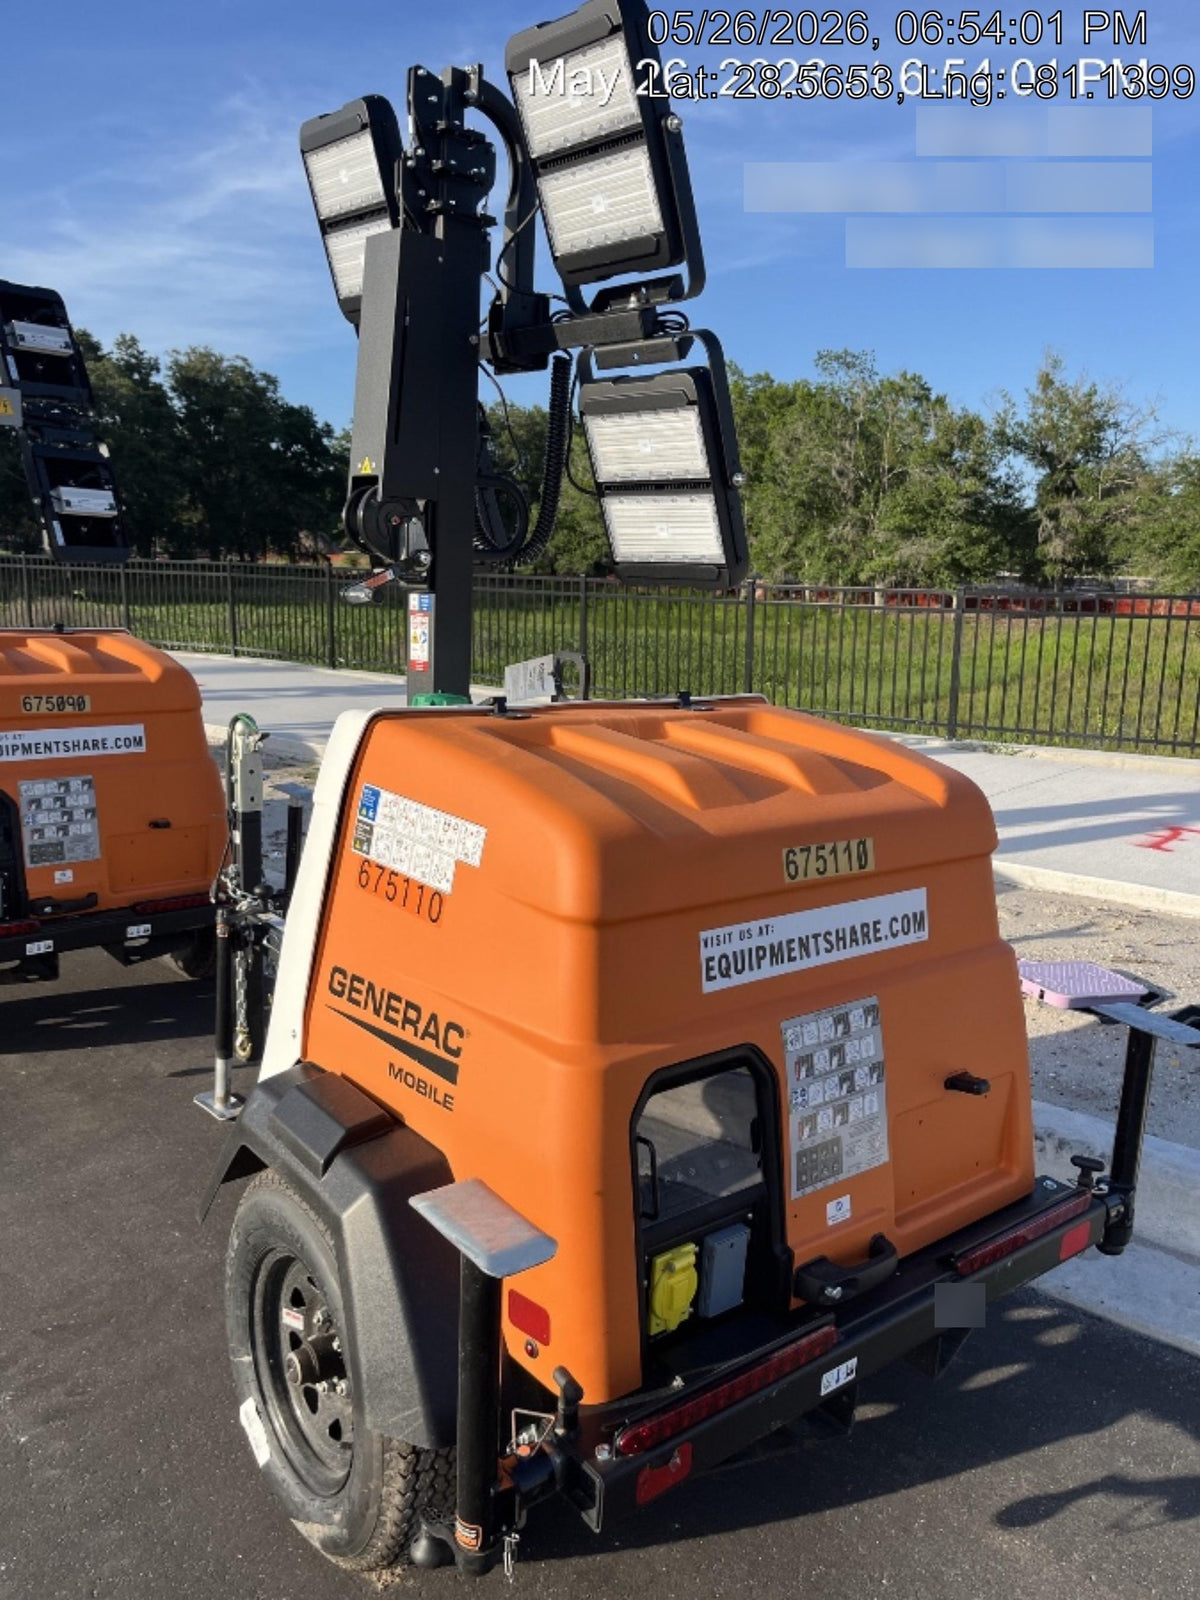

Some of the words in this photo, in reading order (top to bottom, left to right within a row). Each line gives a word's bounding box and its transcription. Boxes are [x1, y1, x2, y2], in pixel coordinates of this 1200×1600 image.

[22, 695, 86, 712] 675090
[785, 838, 868, 881] 675110
[358, 859, 444, 924] 675110
[702, 932, 733, 949] VISIT
[739, 929, 753, 942] US
[758, 924, 775, 937] AT:
[704, 910, 926, 983] EQUIPMENTSHARE.COM
[328, 965, 465, 1058] GENERAC
[388, 1061, 455, 1112] MOBILE
